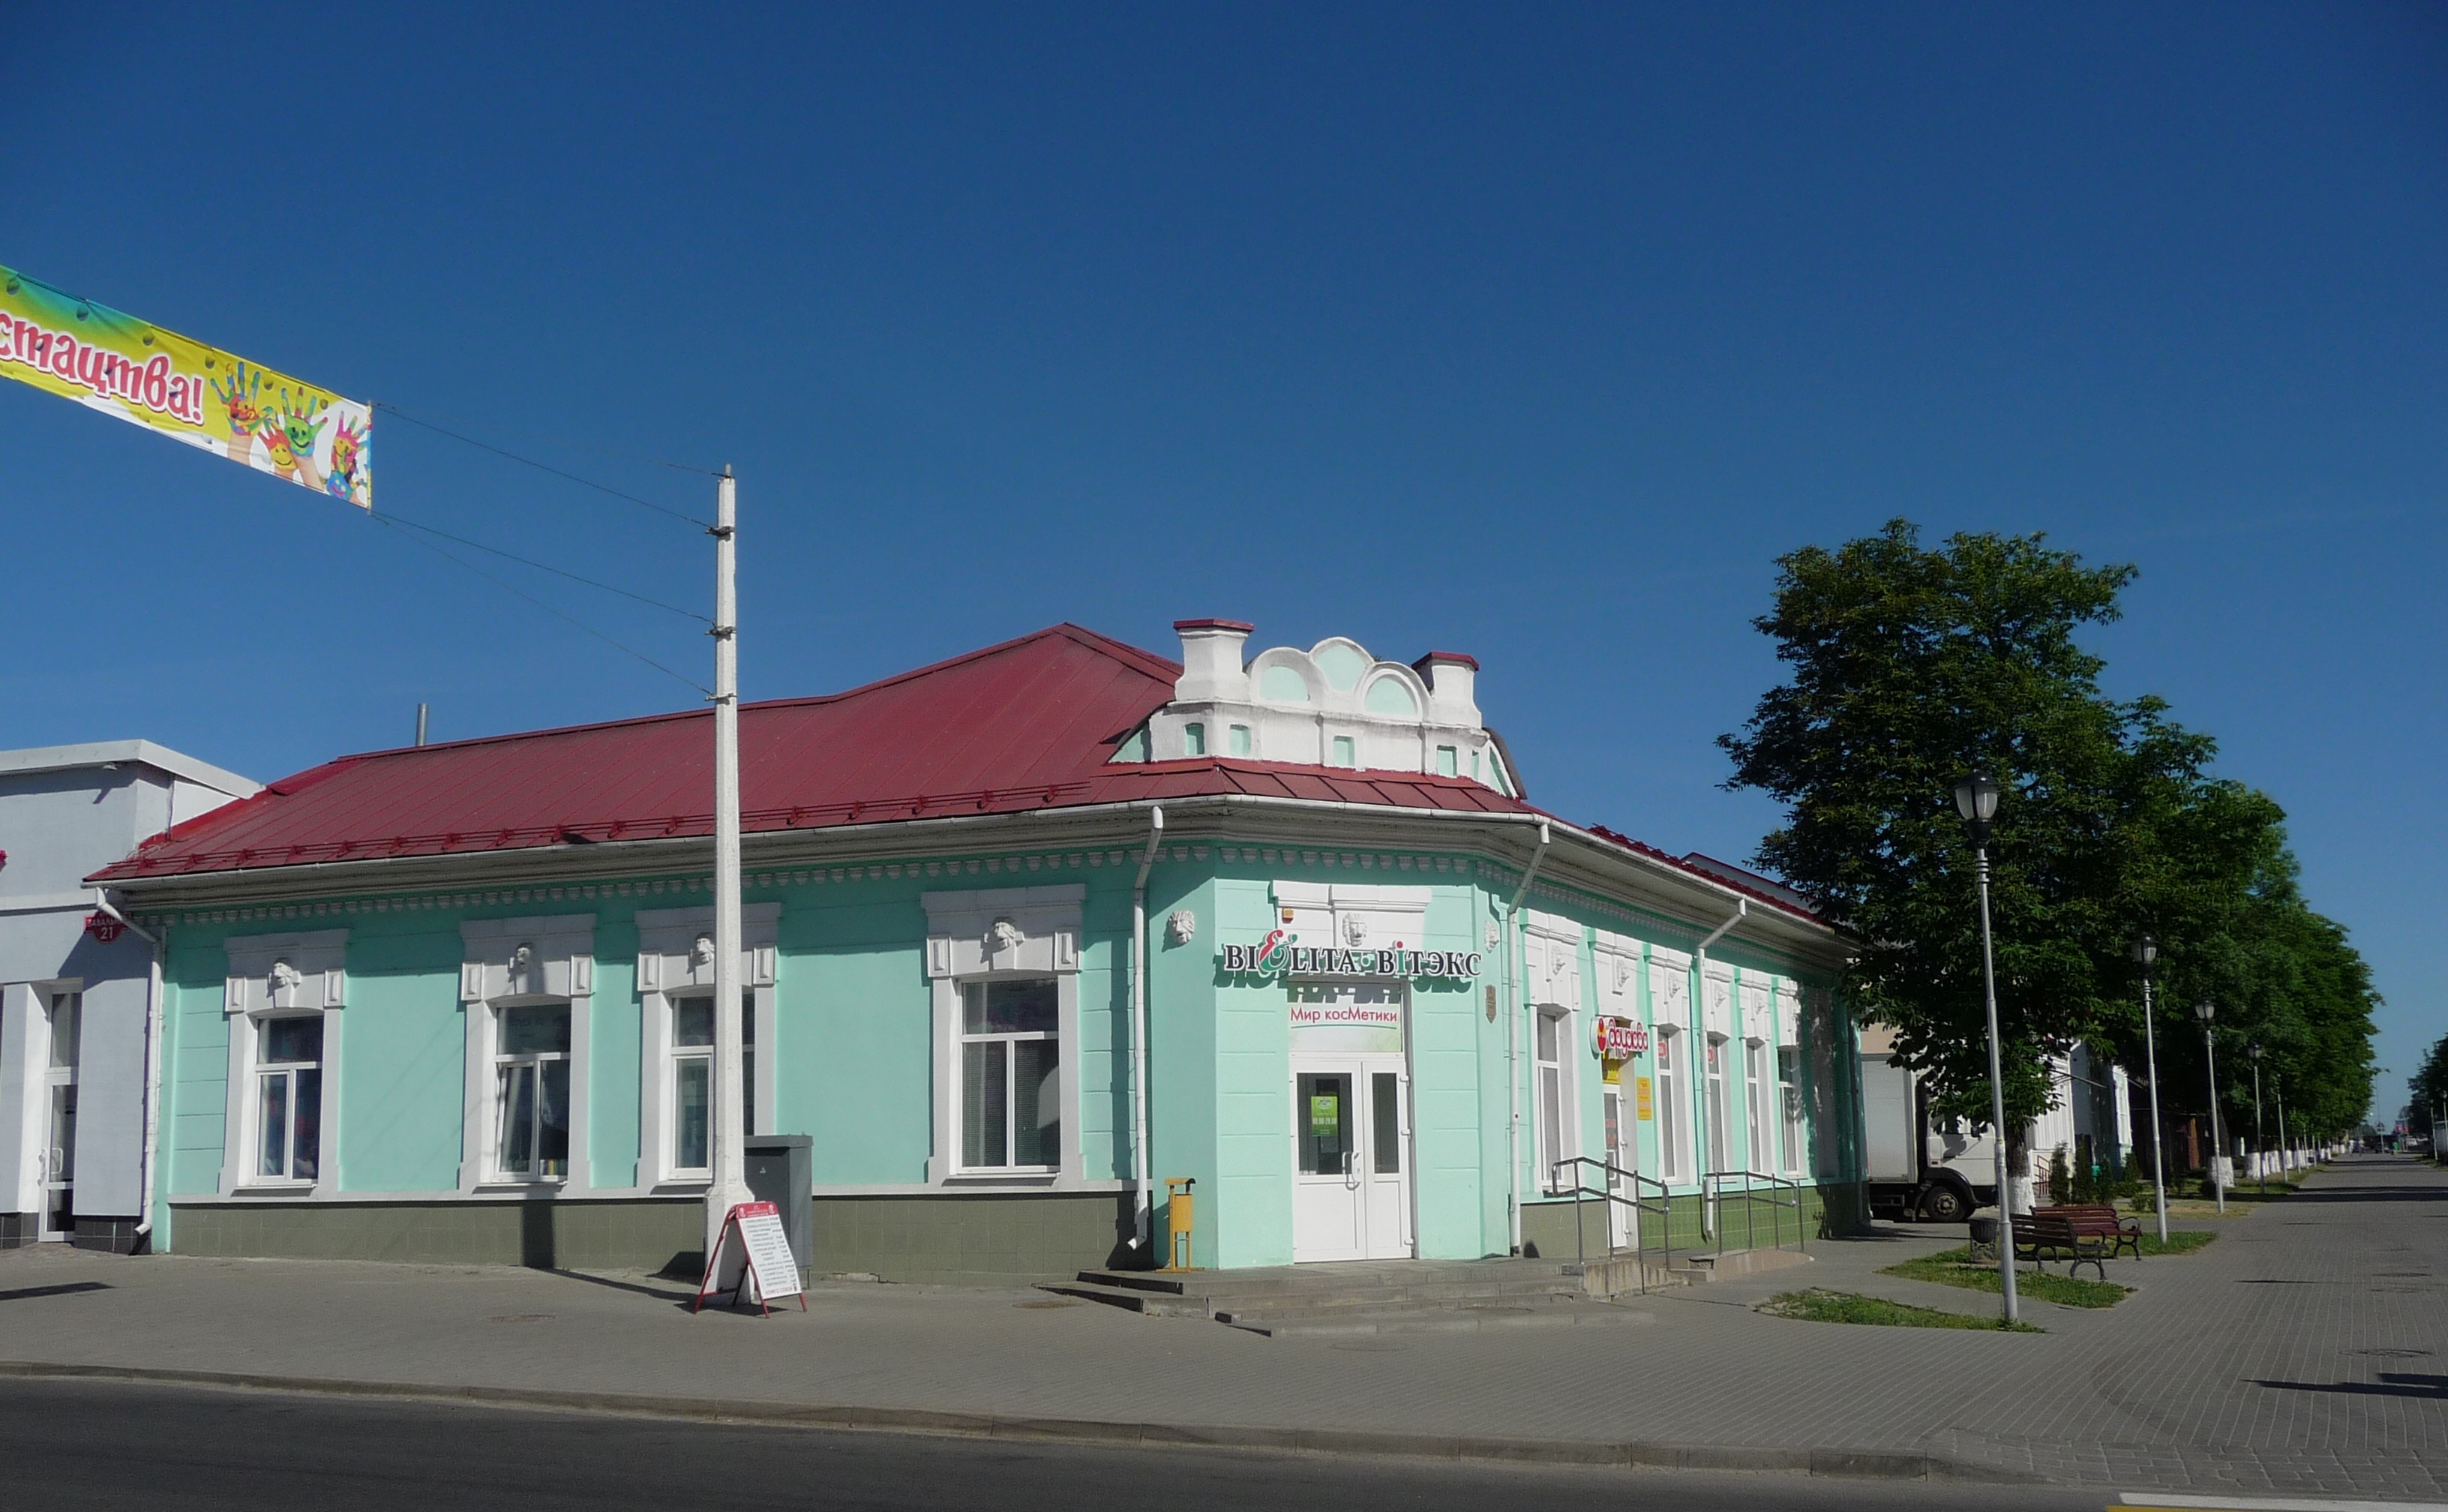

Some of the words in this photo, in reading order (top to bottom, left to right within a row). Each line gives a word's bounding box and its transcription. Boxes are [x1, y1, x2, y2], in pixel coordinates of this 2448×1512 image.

[100, 926, 113, 940] 21
[1290, 1006, 1322, 1023] Мир
[1608, 1018, 1648, 1058] дружба
